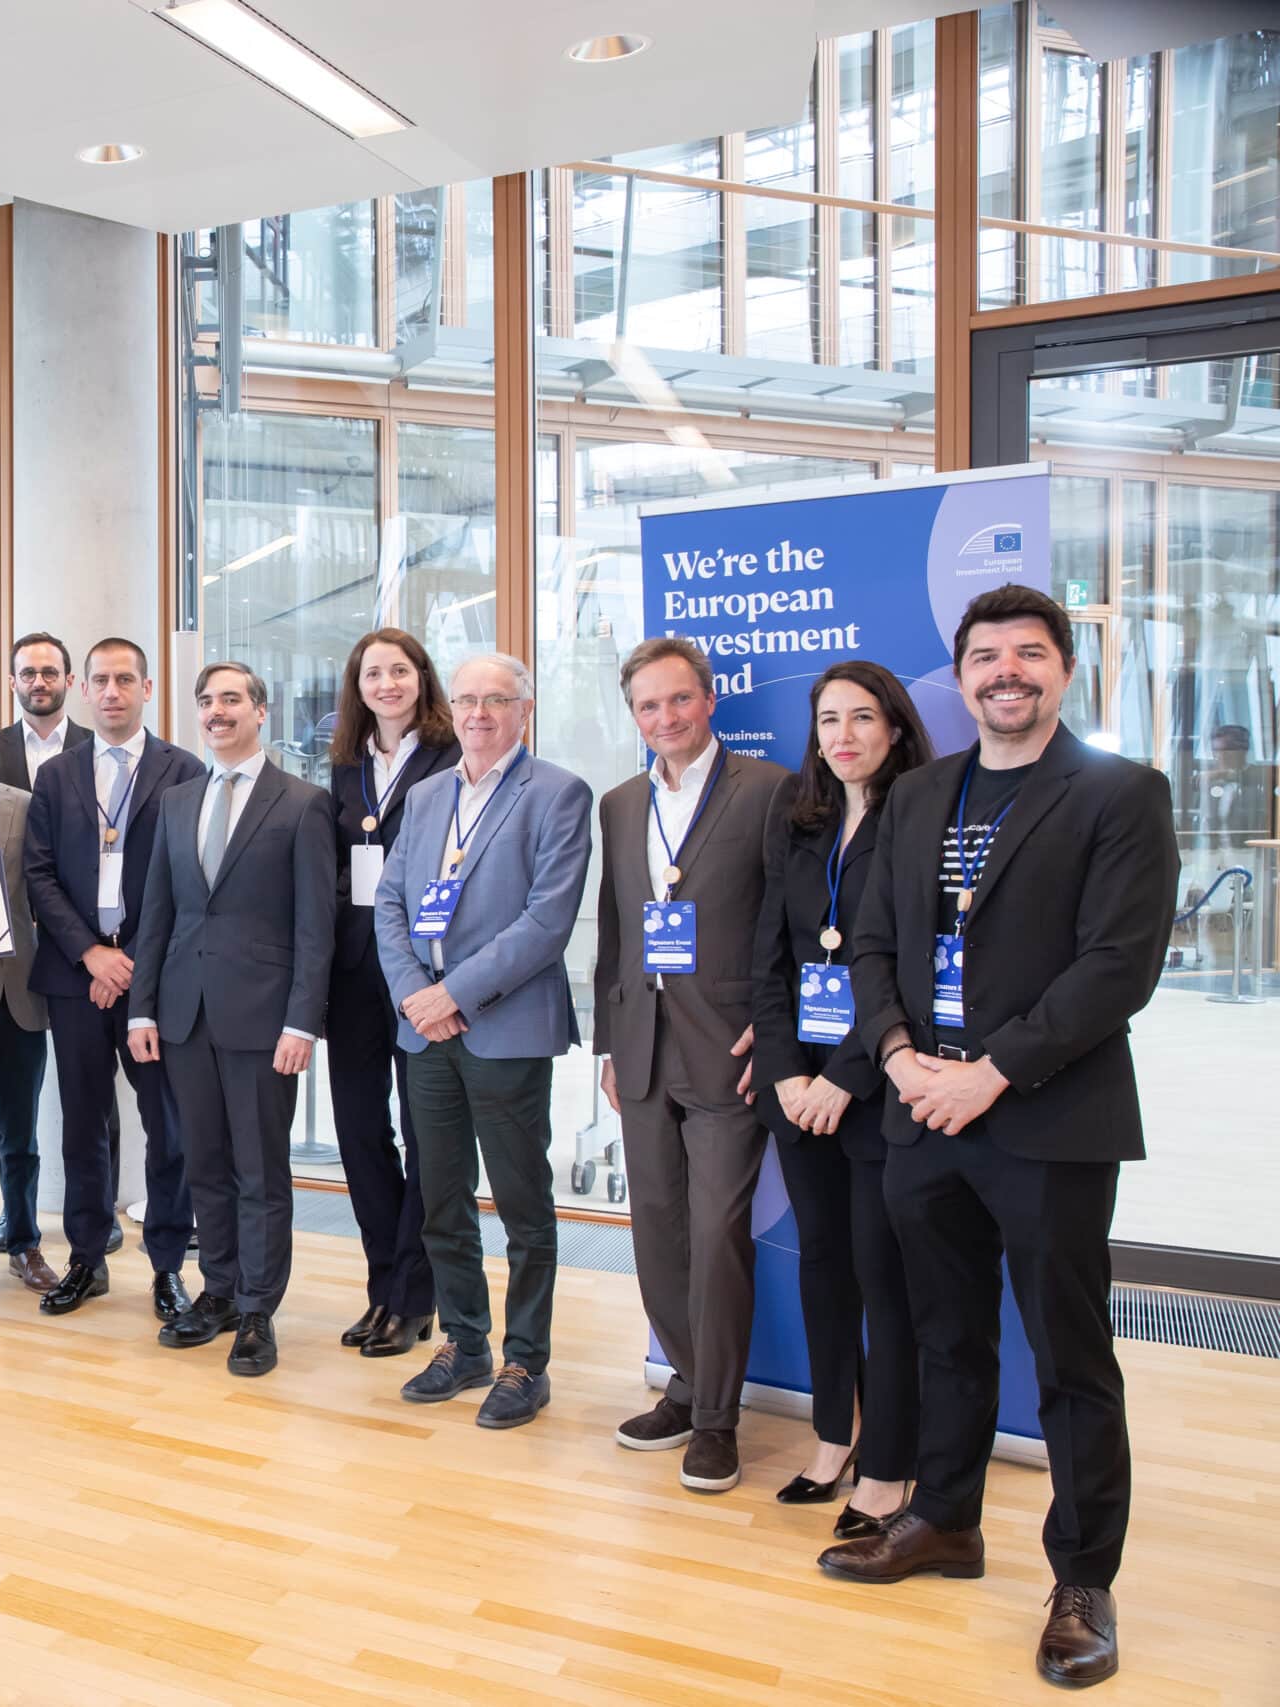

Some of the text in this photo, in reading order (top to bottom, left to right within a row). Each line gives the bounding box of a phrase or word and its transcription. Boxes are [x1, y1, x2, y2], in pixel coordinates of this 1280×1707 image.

[766, 540, 825, 574] the
[664, 586, 835, 624] European
[711, 662, 754, 696] nd
[718, 729, 776, 741] business.
